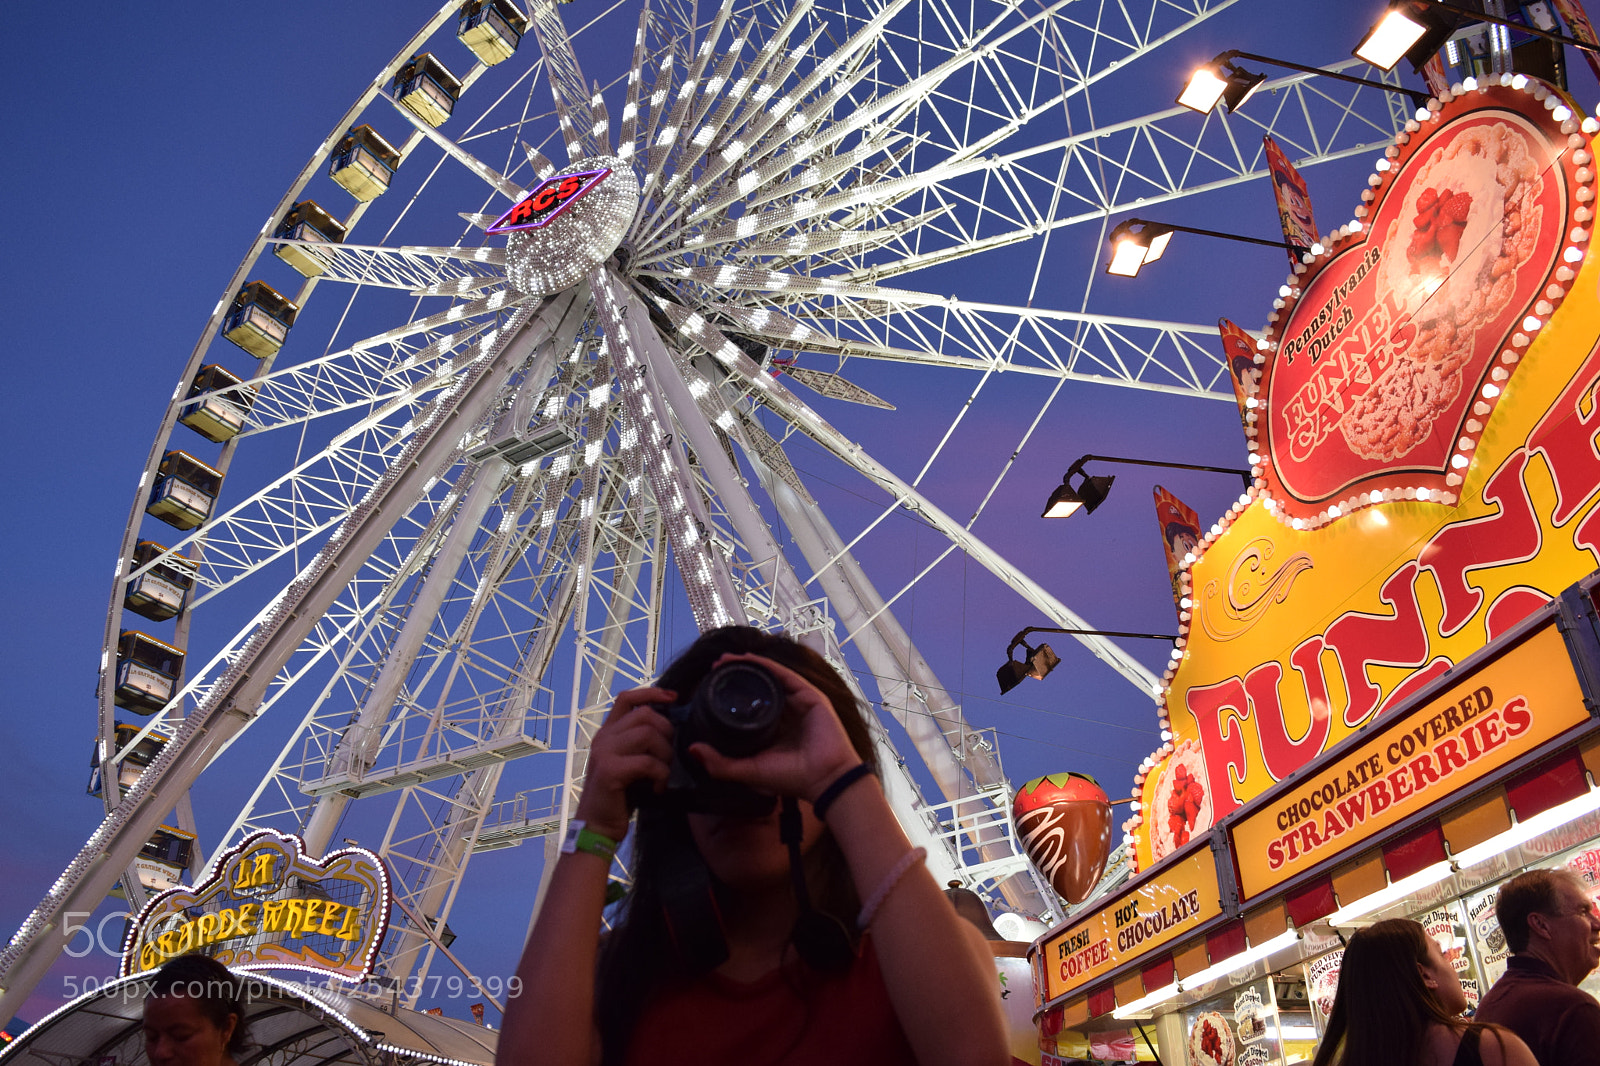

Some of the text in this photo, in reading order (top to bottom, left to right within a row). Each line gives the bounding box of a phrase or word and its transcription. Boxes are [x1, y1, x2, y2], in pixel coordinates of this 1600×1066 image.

[509, 176, 580, 225] RCS
[1284, 247, 1381, 364] Pennsylvania
[1308, 307, 1354, 365] Dutch
[1282, 289, 1408, 440] FUNNEL
[1290, 312, 1419, 462] CAKES
[1276, 752, 1384, 832] CHOCOLATE
[1386, 685, 1494, 765] COVERED
[1267, 696, 1532, 871] STRAWBERRIES
[234, 853, 277, 889] LA
[140, 898, 361, 971] GRANDE WHEEL
[1114, 900, 1139, 929] HOT
[1117, 889, 1201, 953] CHOCOLATE
[1432, 910, 1458, 922] Dipped
[1470, 902, 1488, 920] Hand
[1058, 928, 1090, 960] FRESH
[1059, 937, 1110, 983] COFFEE
[1310, 959, 1322, 974] RED
[1323, 951, 1344, 962] VELVE
[1485, 951, 1511, 965] Choco
[1310, 962, 1333, 983] FUNNEL
